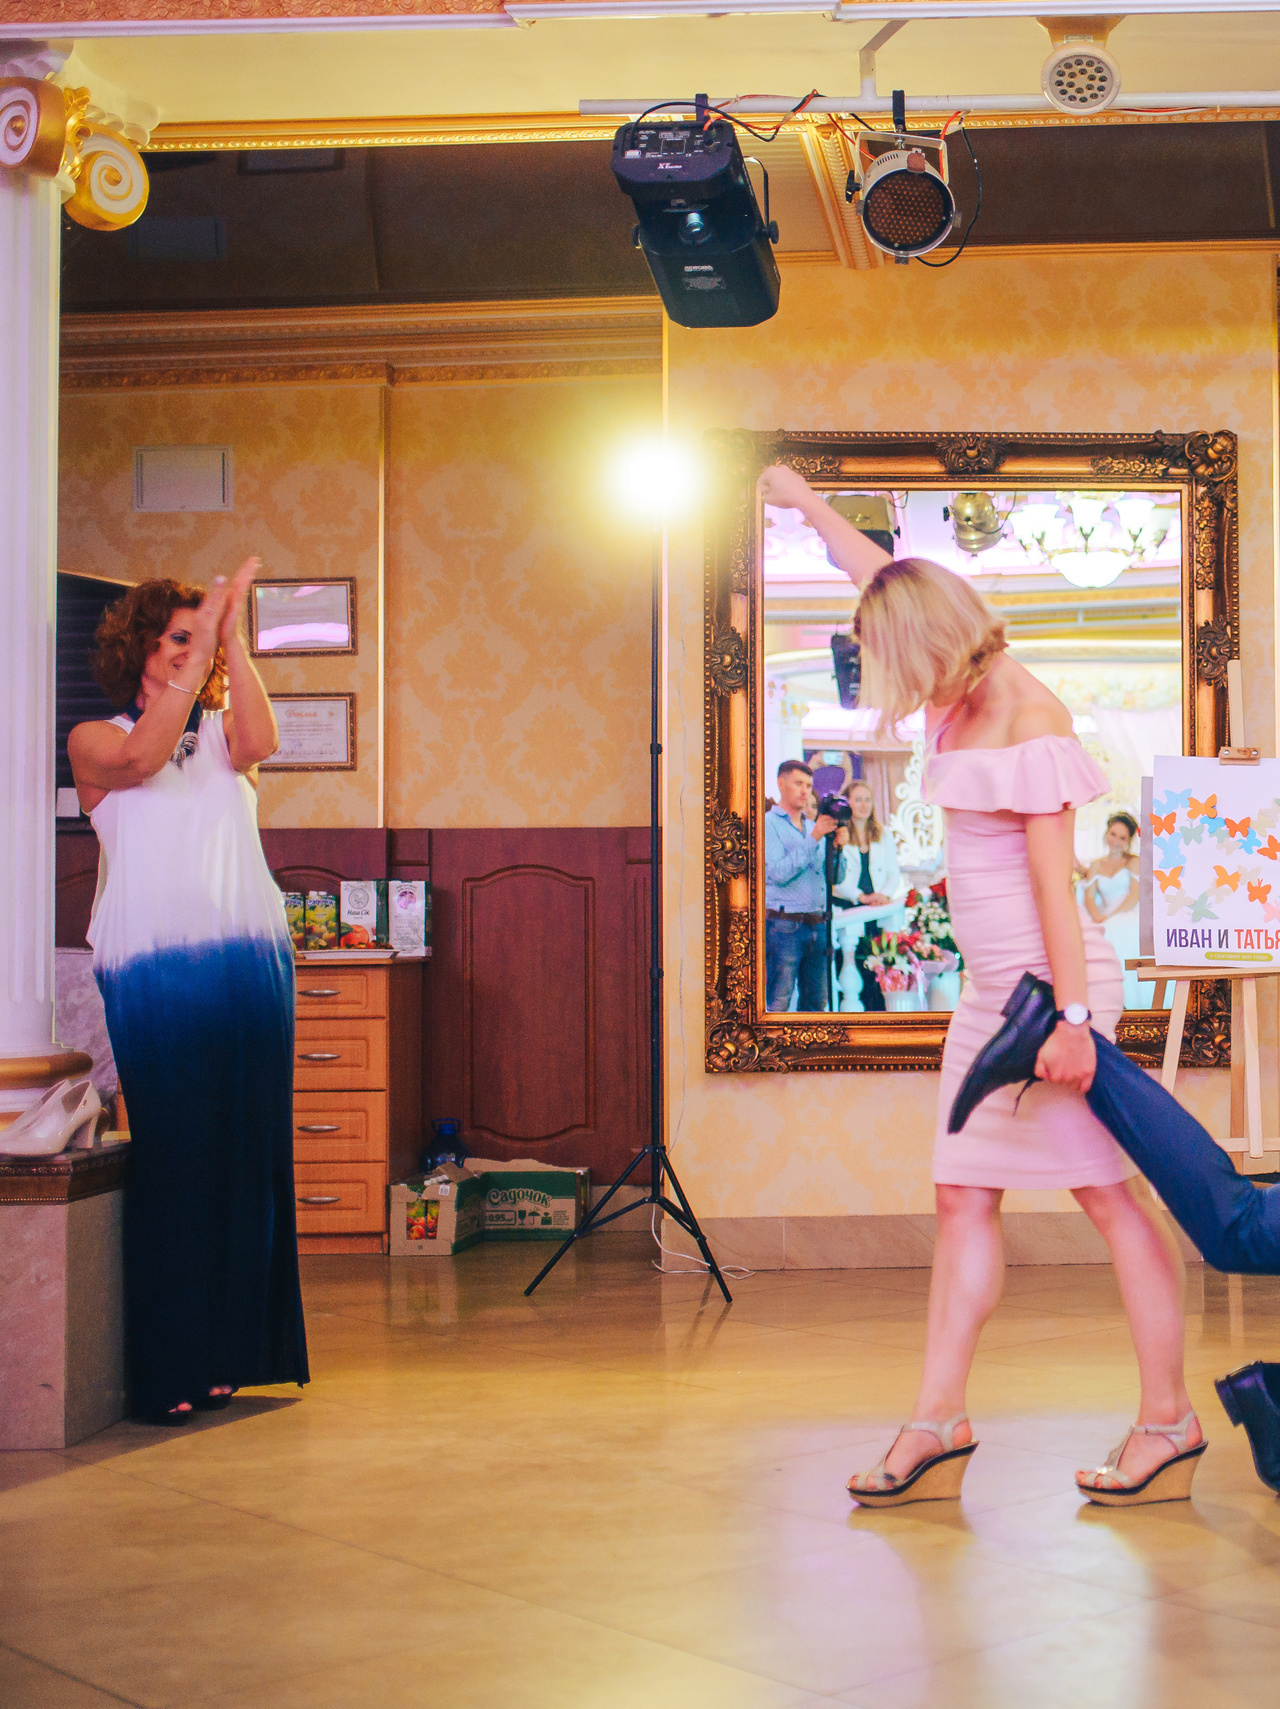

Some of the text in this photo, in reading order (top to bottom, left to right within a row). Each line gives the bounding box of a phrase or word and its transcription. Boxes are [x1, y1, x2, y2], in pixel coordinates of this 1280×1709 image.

[1166, 928, 1212, 949] ИВАН
[1218, 928, 1229, 949] И
[487, 1188, 551, 1207] Садочок
